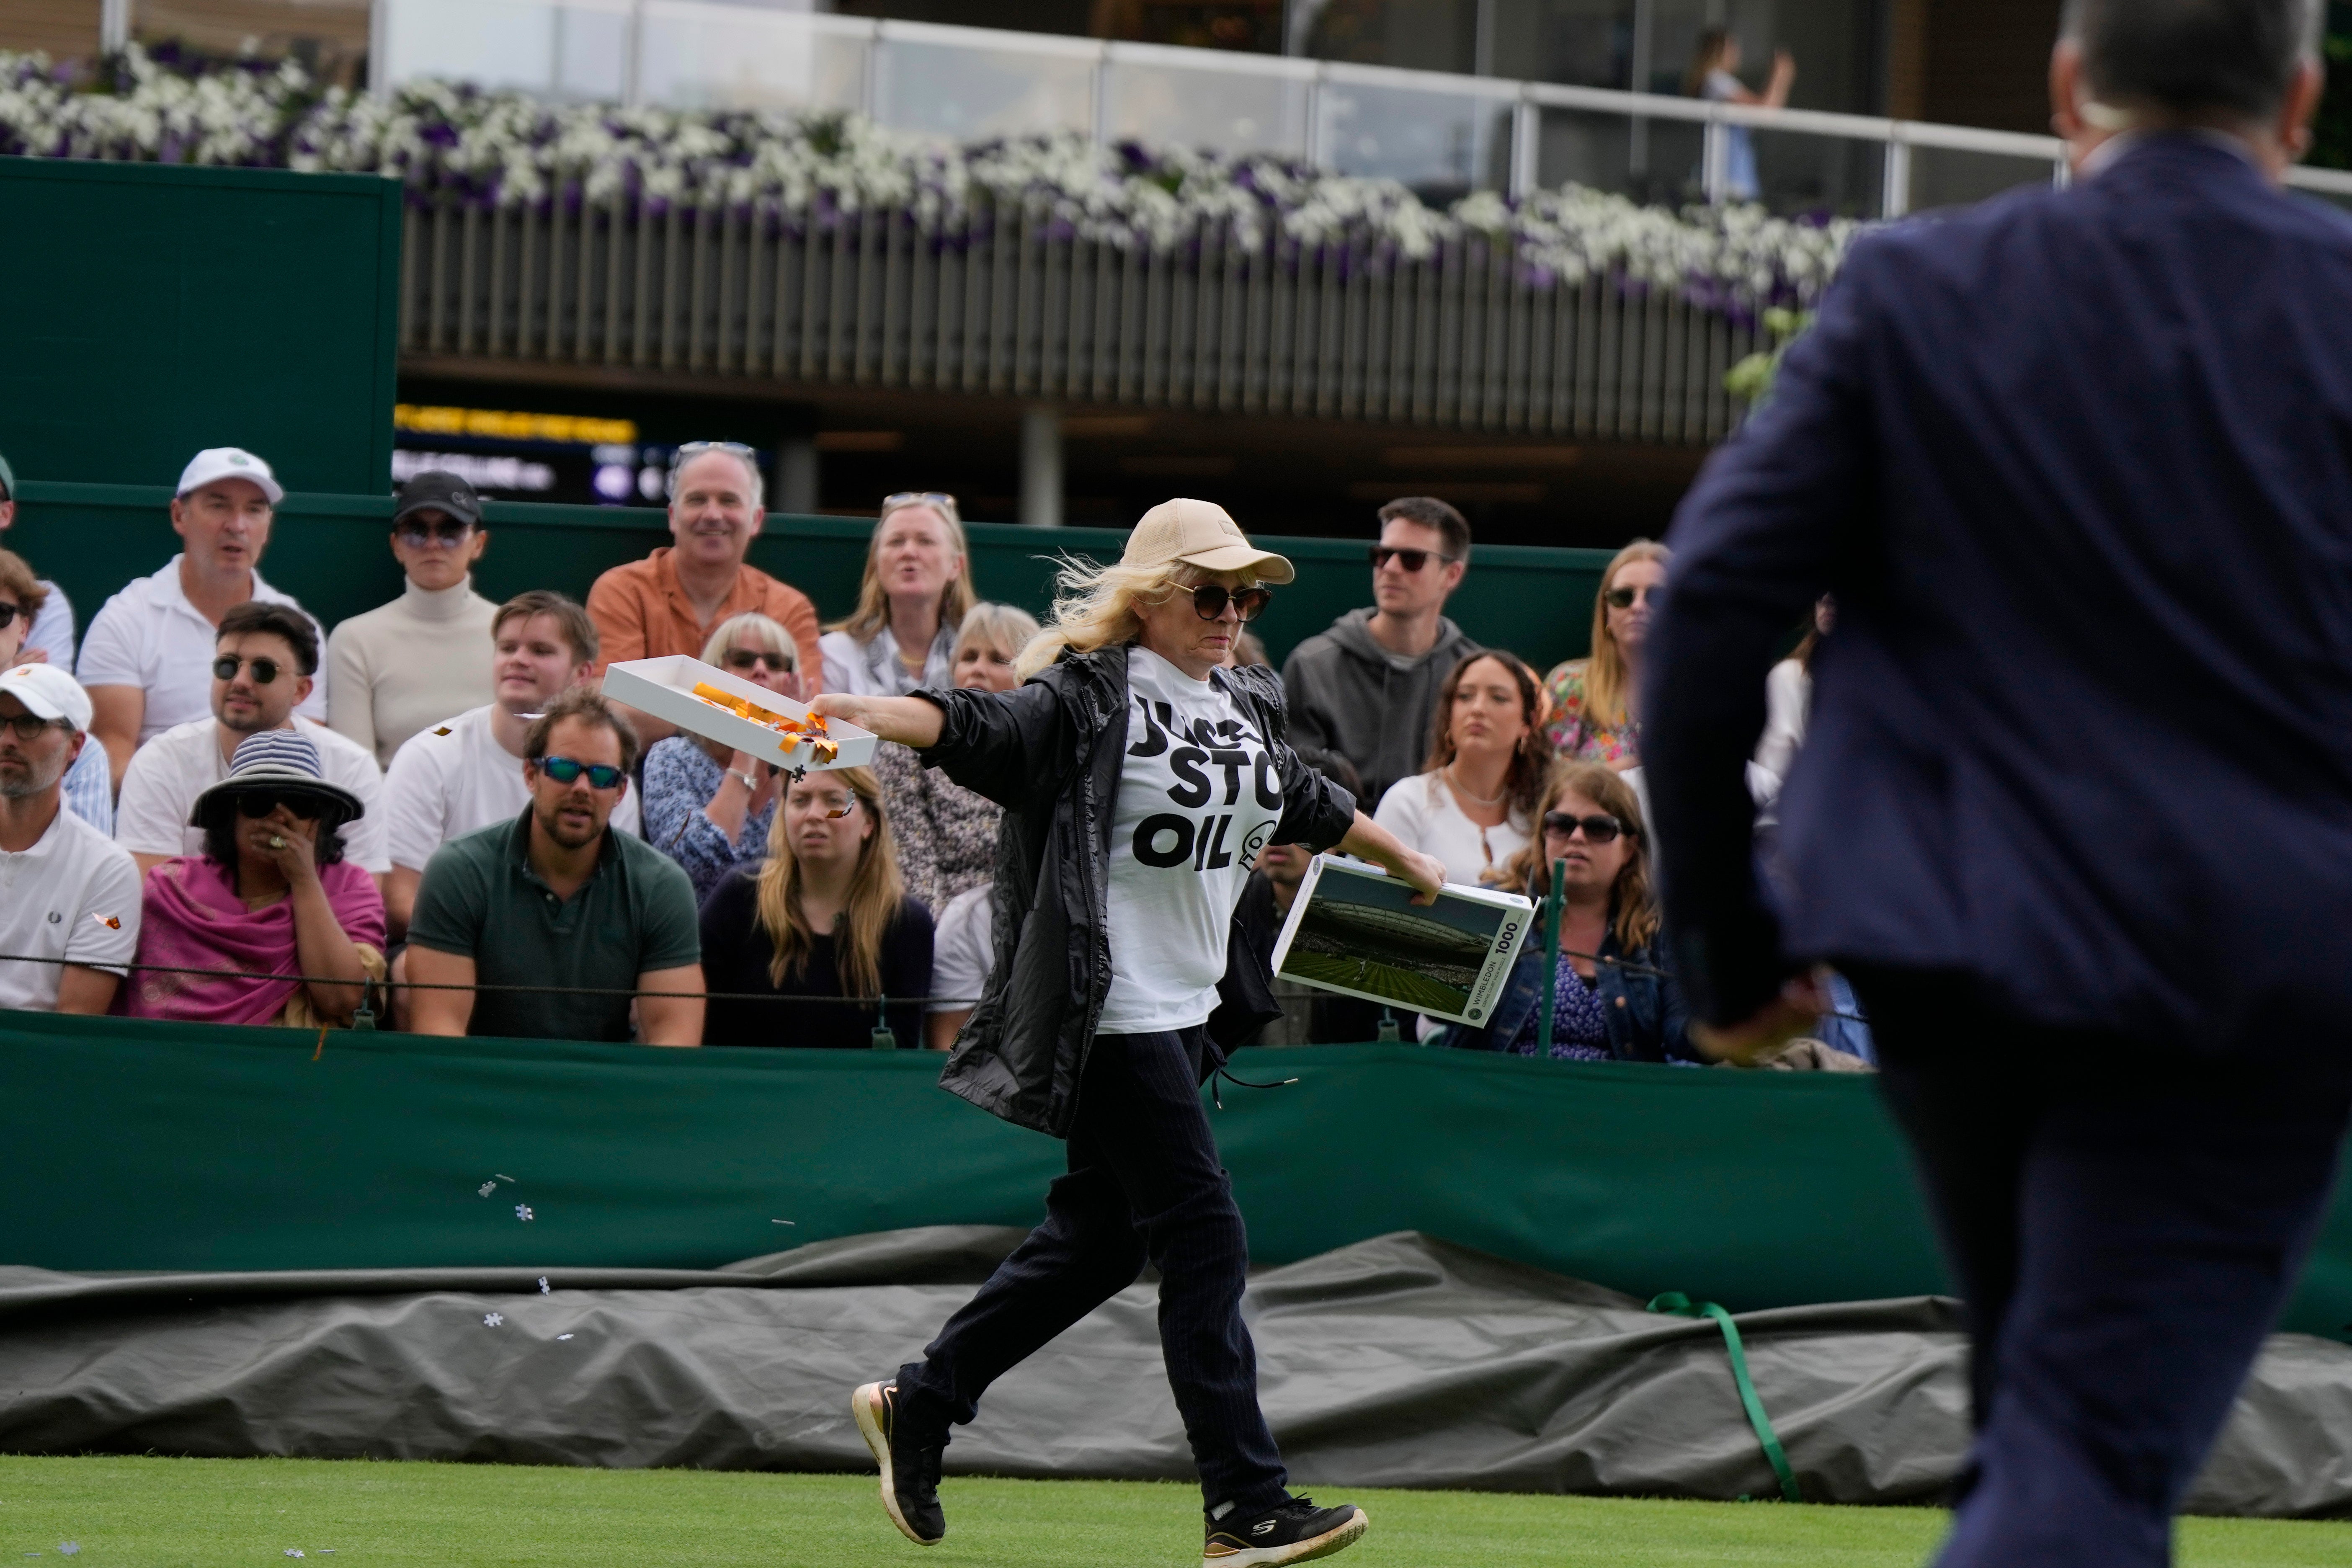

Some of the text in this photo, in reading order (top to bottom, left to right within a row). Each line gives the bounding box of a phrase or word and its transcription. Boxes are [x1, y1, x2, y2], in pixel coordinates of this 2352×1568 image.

[1167, 746, 1283, 811] STO
[1132, 813, 1233, 871] OIL
[1495, 922, 1518, 954] 1000
[1473, 961, 1496, 1005] WIMBLEDON
[1482, 994, 1491, 1007] CENTRE
[1497, 957, 1506, 971] PUZZLE
